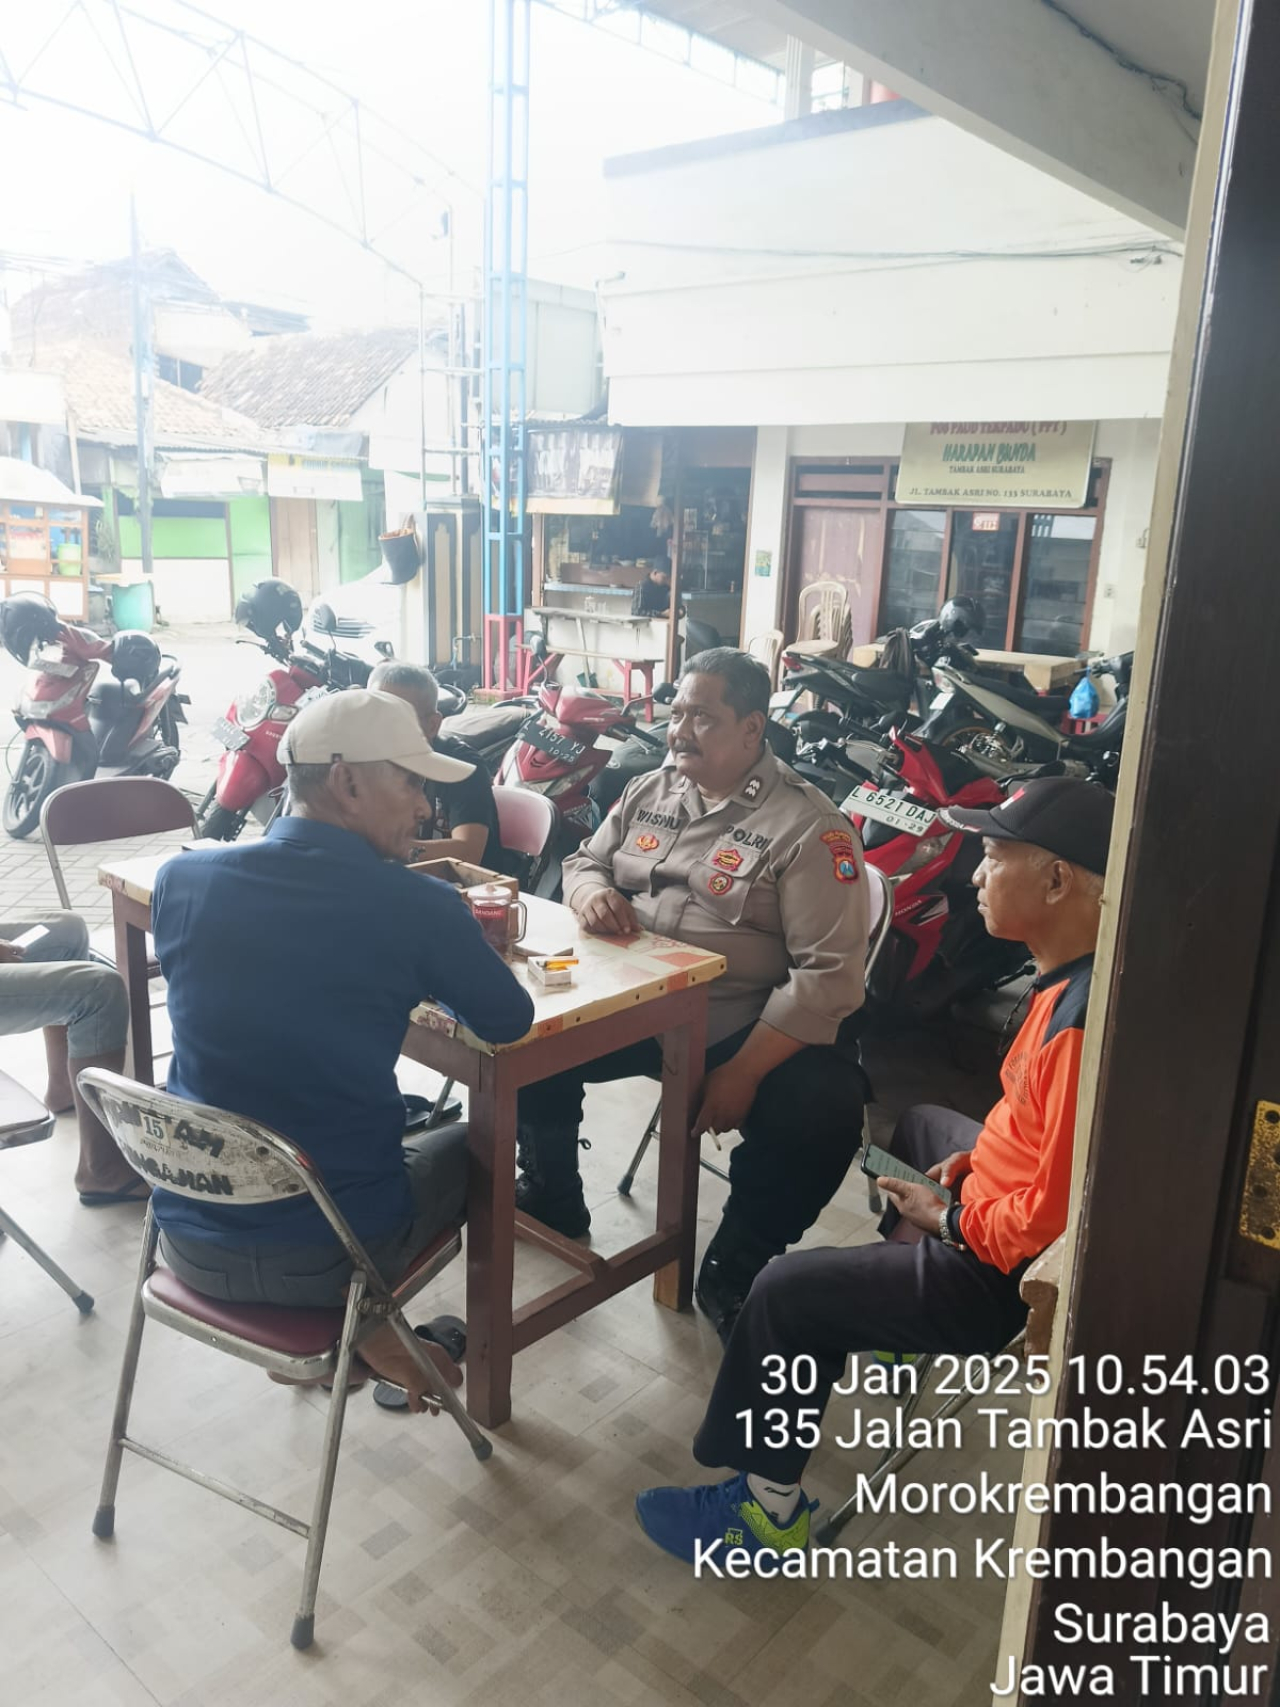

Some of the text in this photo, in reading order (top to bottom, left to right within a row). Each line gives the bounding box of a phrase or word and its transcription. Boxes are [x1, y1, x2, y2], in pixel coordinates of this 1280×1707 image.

[922, 487, 960, 497] TAMBAK
[962, 488, 985, 497] ASRI
[1019, 488, 1072, 498] SURABAYA
[851, 787, 860, 798] L
[865, 791, 903, 813] 6521
[905, 805, 936, 824] DAJ
[636, 810, 680, 830] WISNU
[725, 824, 773, 850] POLRI
[143, 1115, 164, 1140] 15
